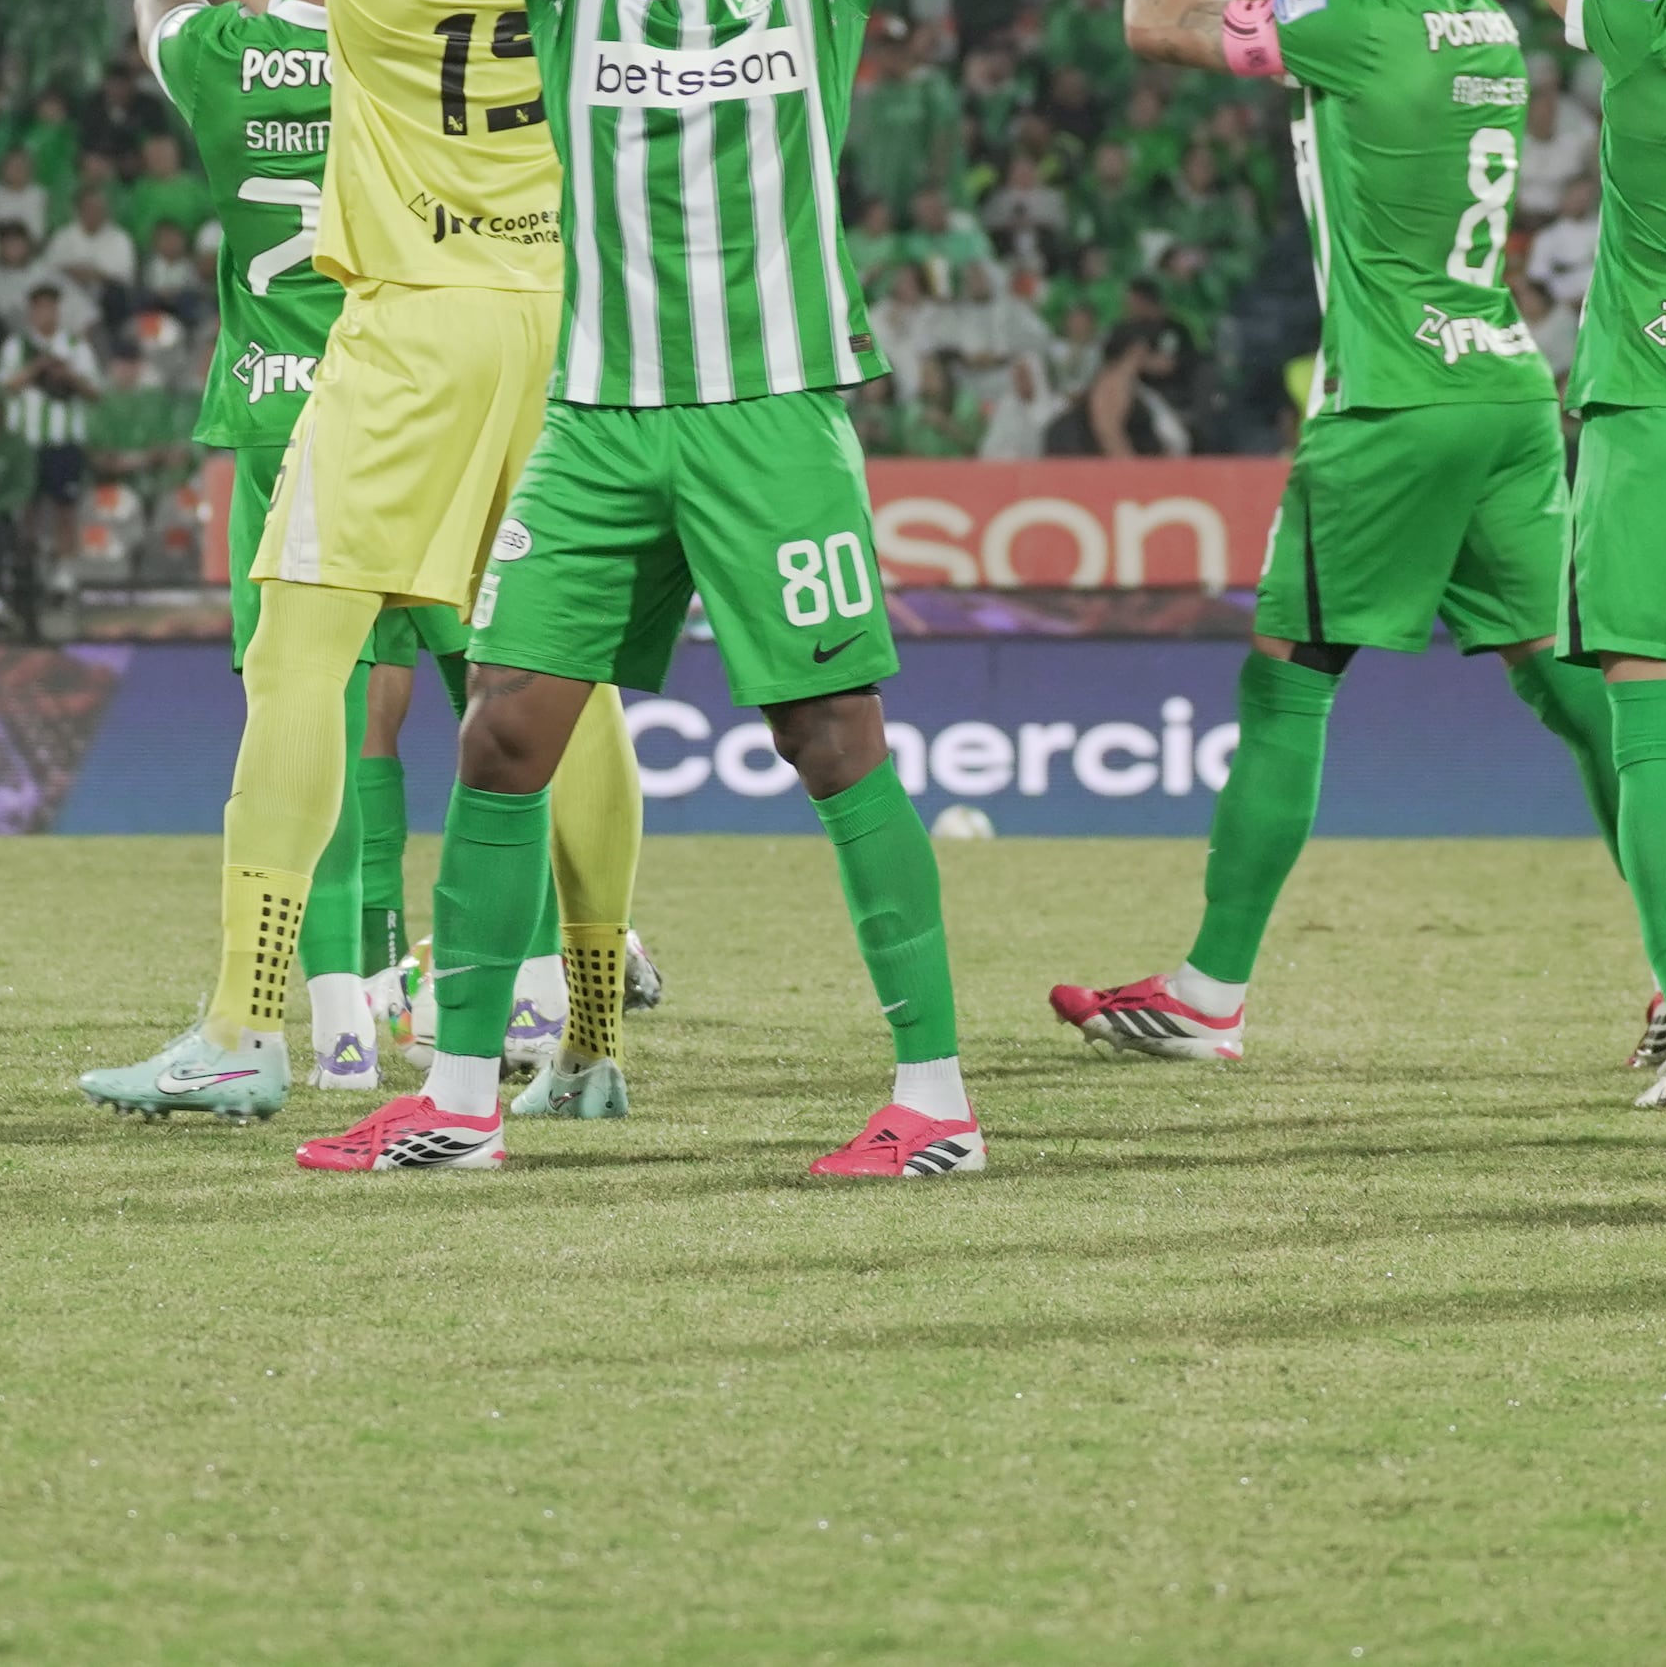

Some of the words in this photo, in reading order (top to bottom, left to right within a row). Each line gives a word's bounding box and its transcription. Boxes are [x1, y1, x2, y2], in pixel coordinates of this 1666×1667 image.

[595, 50, 797, 96] betsson
[1446, 127, 1518, 287] 8
[247, 353, 318, 404] JFK
[777, 531, 874, 627] 80
